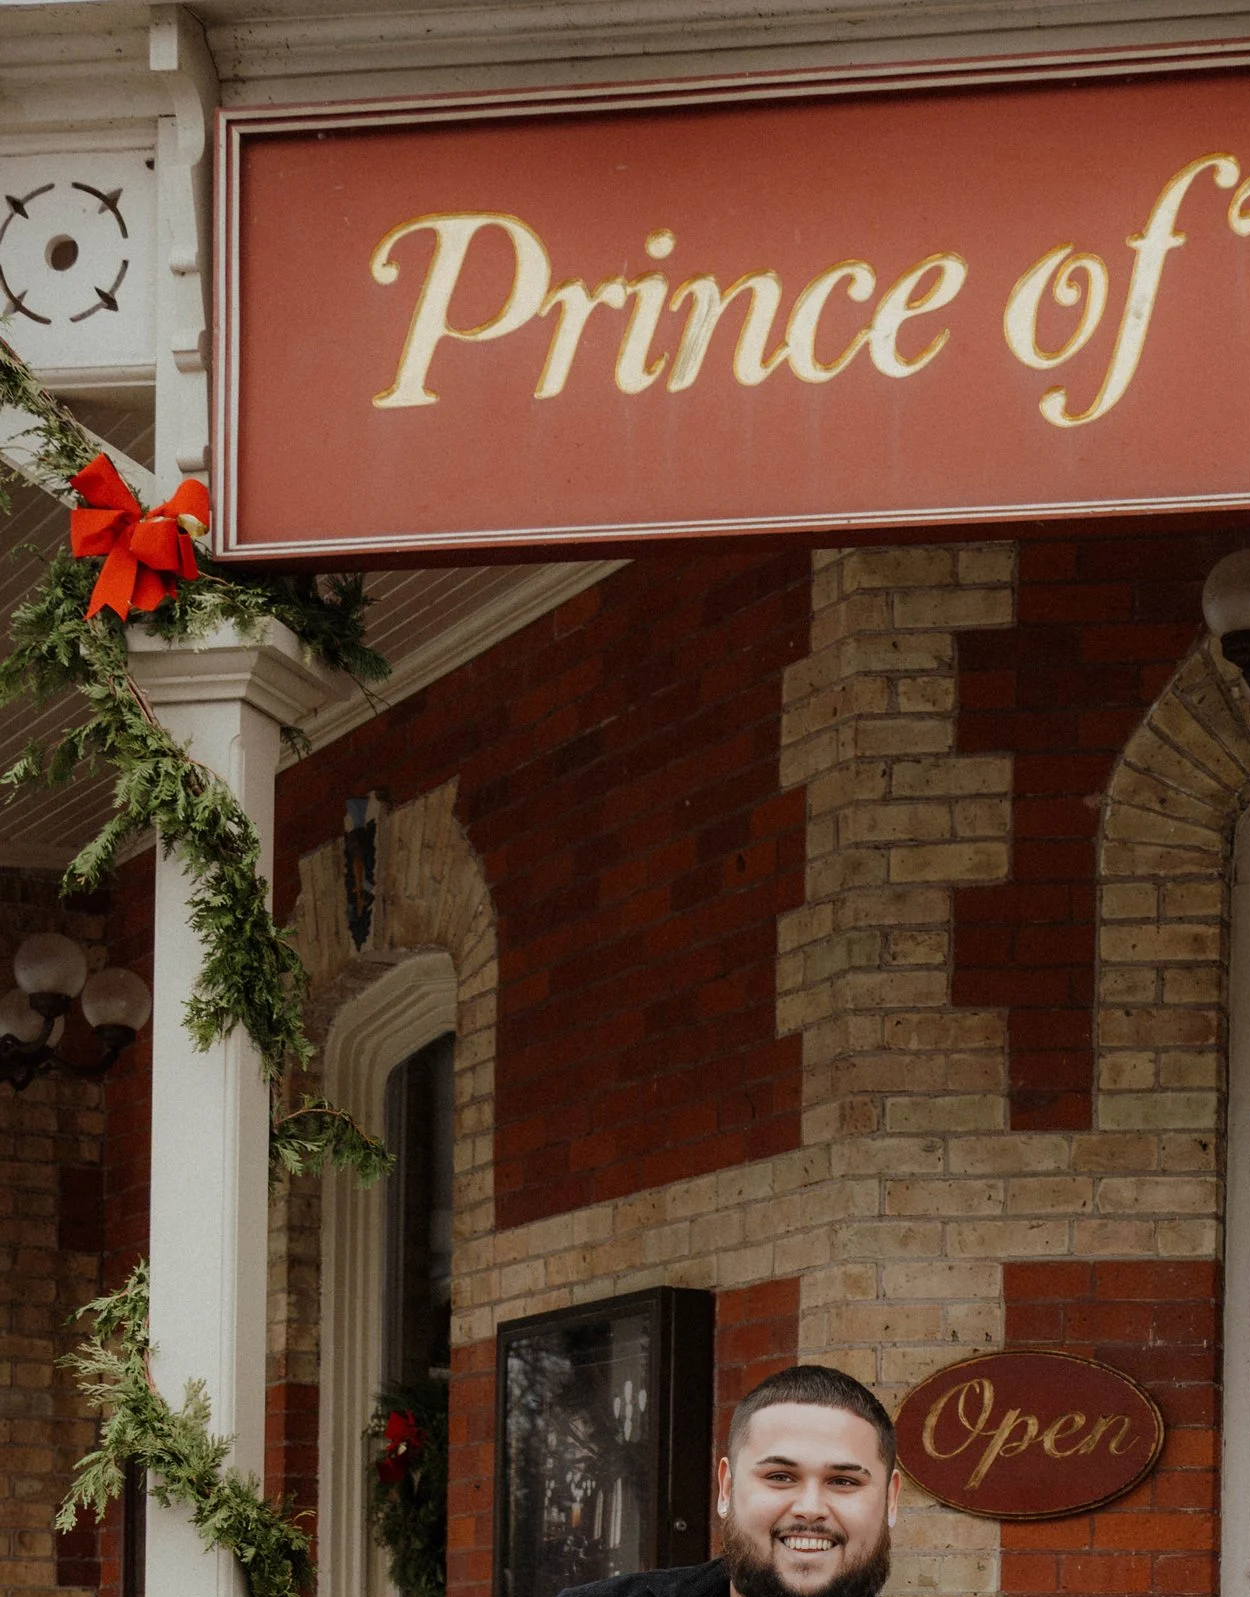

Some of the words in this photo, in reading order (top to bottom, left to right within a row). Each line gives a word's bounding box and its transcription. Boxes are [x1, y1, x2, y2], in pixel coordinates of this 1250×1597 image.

[370, 210, 966, 410] Prince
[1003, 152, 1239, 428] of
[922, 1378, 1140, 1490] Open
